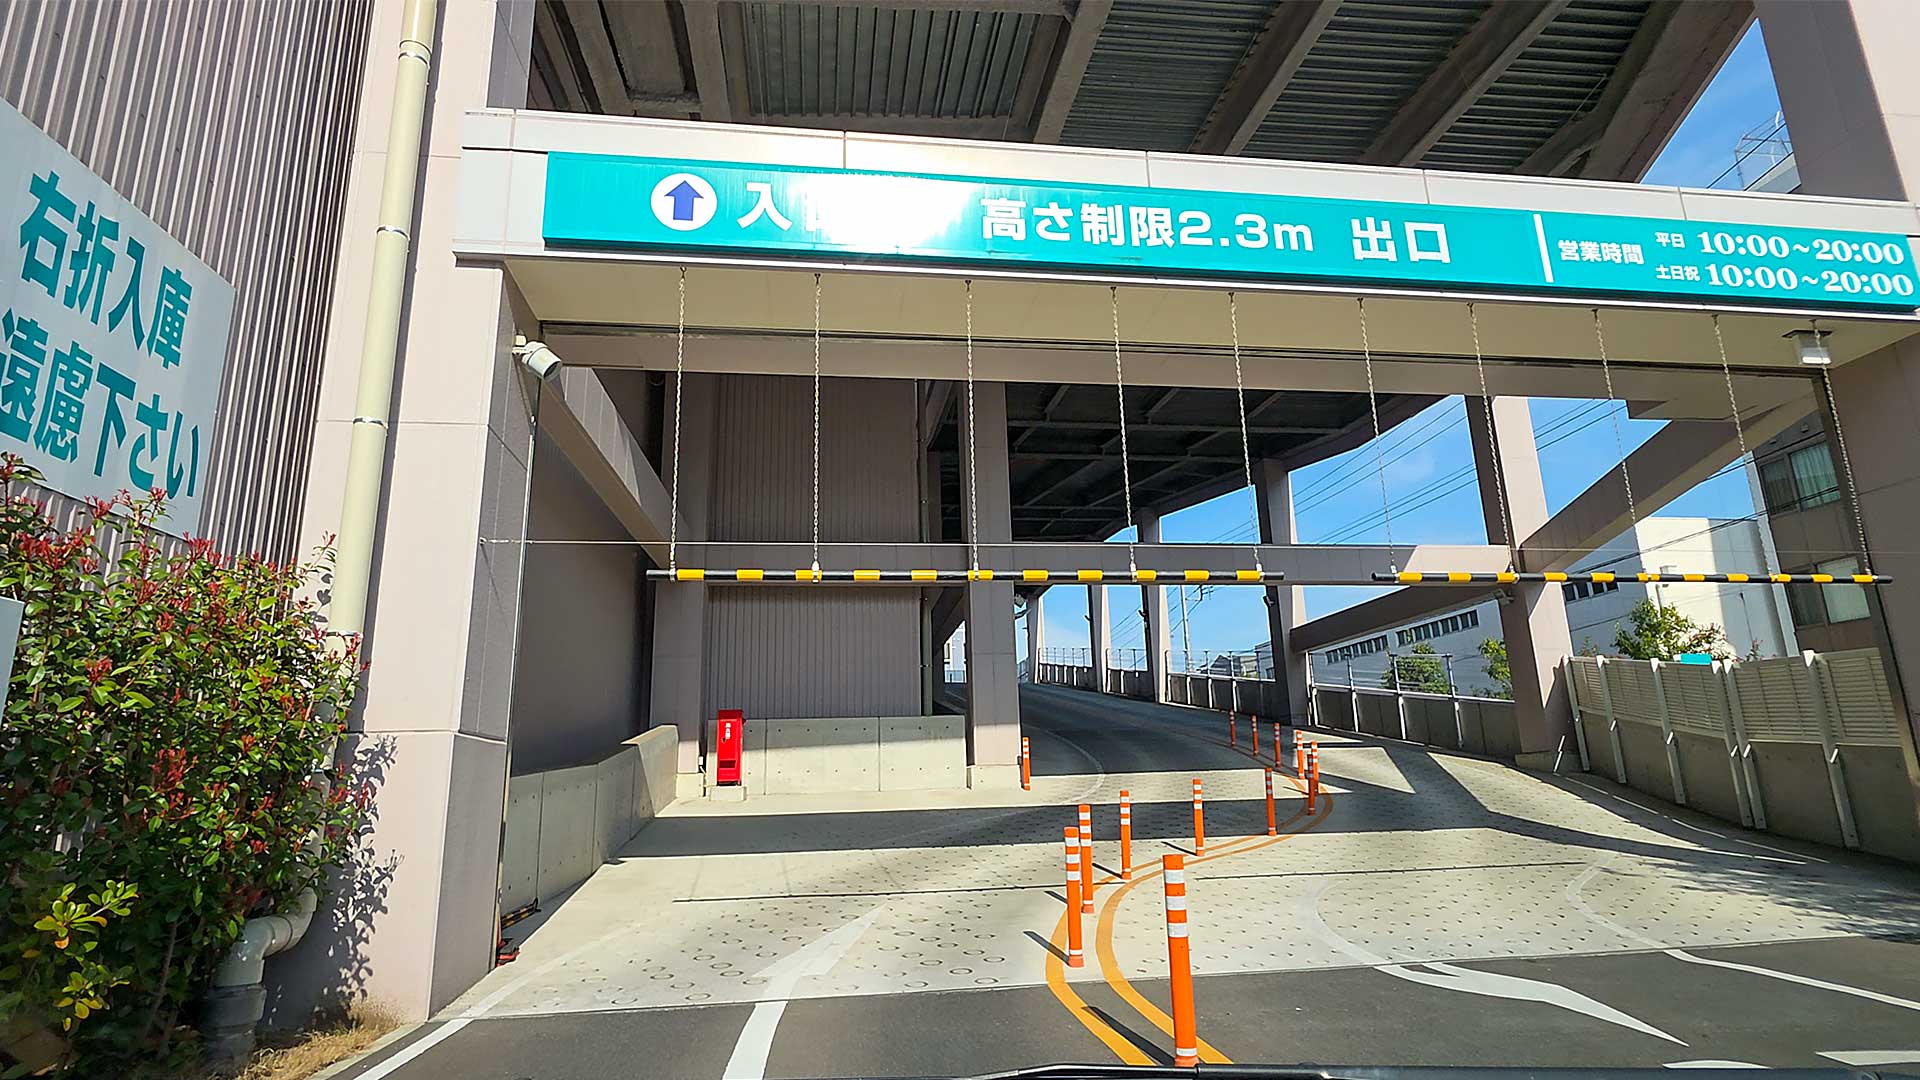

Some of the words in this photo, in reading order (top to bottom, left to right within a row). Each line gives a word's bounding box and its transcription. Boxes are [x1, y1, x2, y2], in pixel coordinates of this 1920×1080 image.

[980, 197, 1314, 253] 高さ制限2.3m
[1351, 215, 1452, 264] 出口
[1557, 238, 1645, 265] 営業時間
[1655, 231, 1685, 249] 平日
[19, 170, 193, 370] 右折入庫
[1655, 264, 1700, 282] 土日祝
[0, 307, 199, 500] 遠慮下さい
